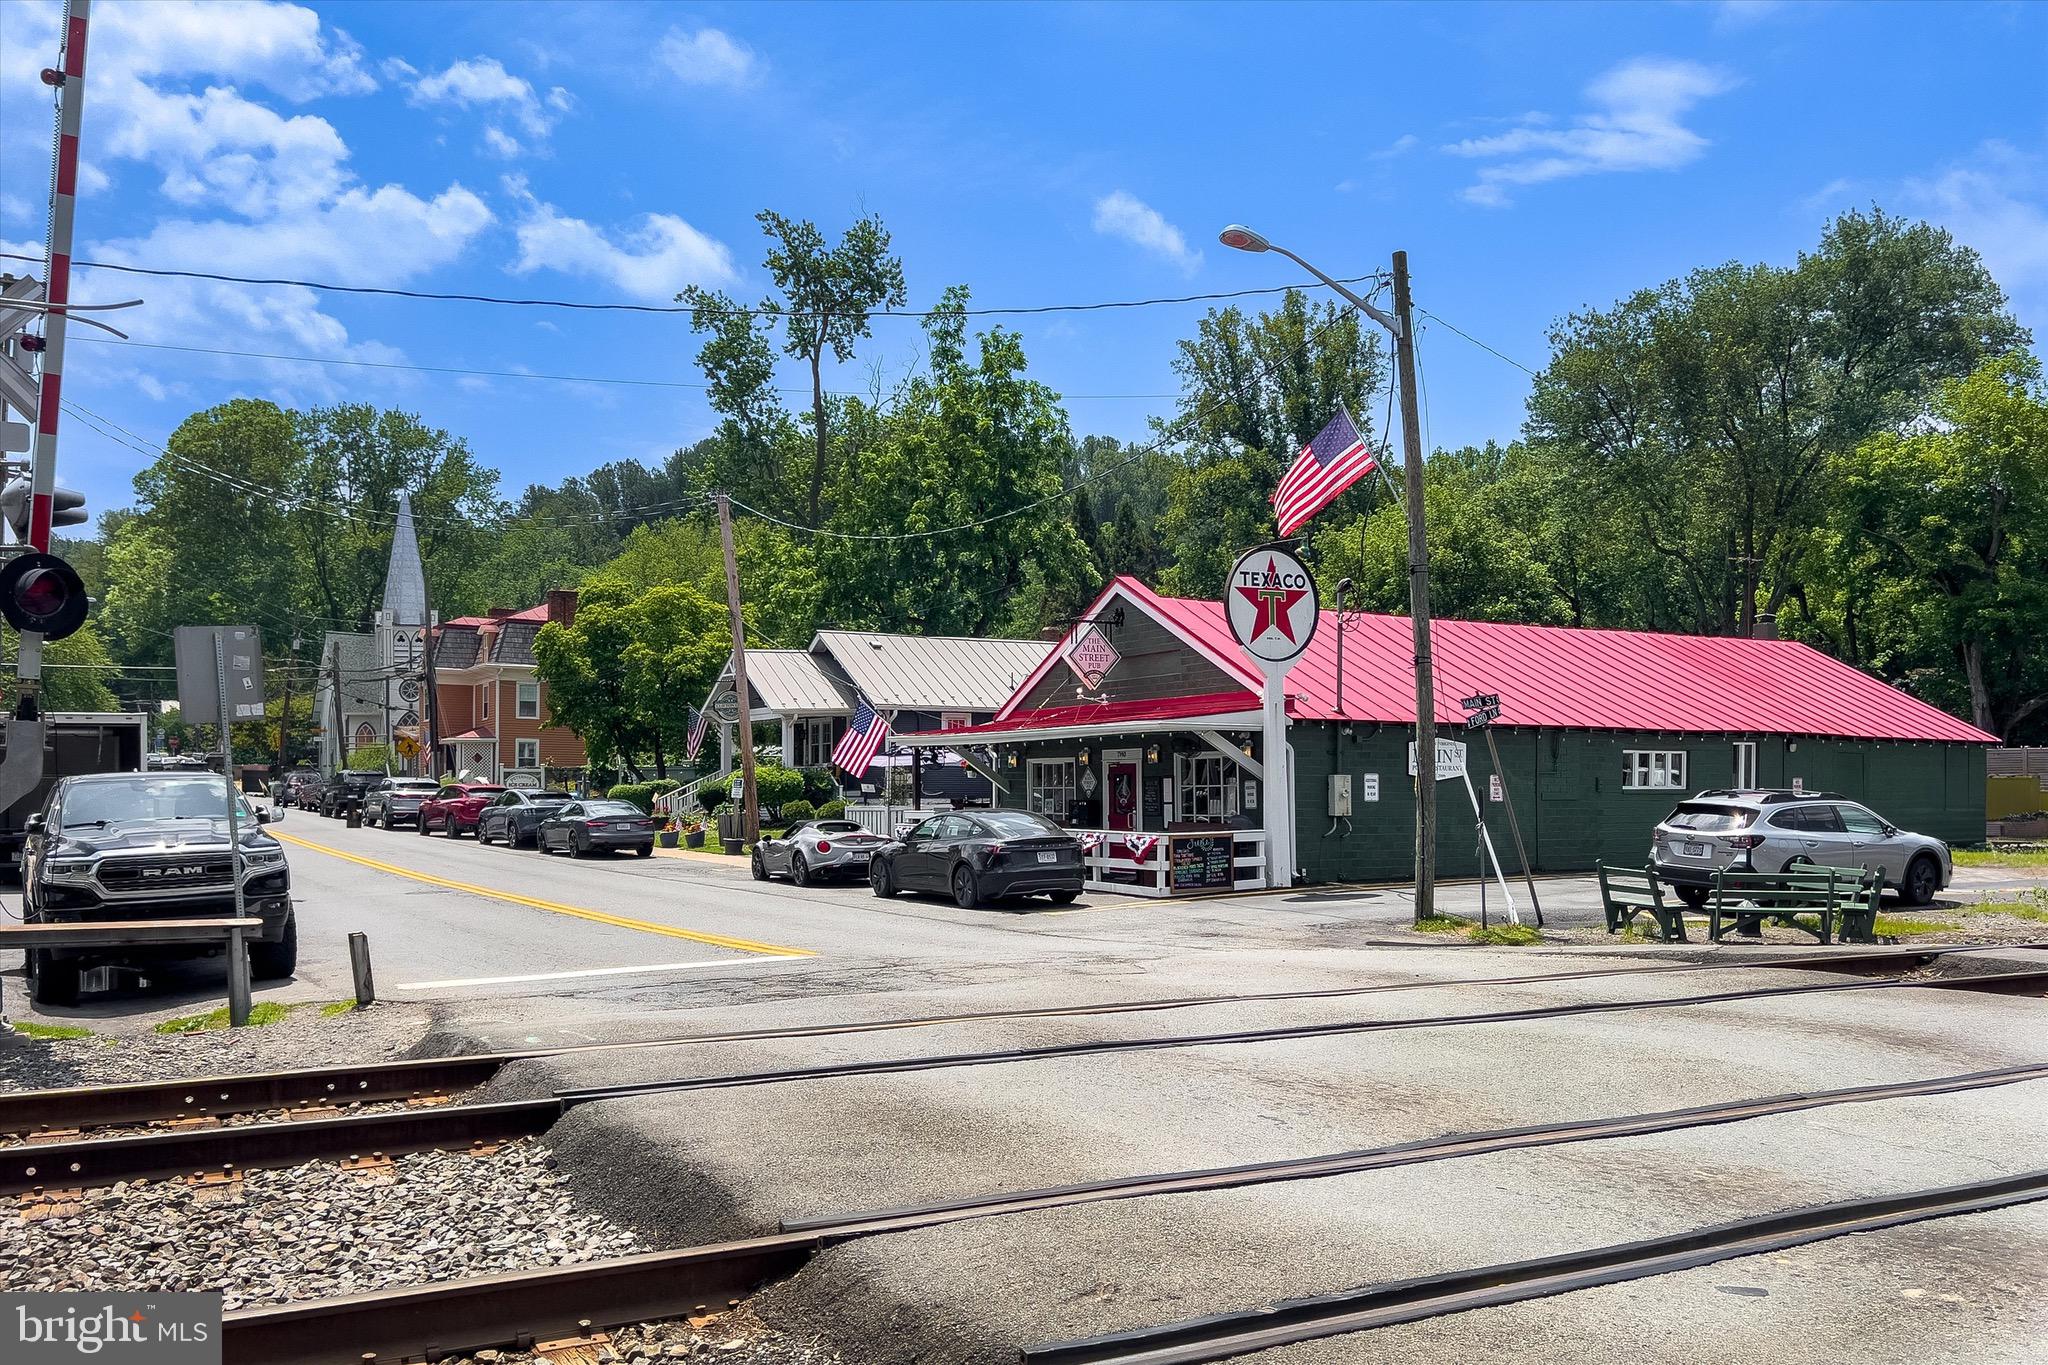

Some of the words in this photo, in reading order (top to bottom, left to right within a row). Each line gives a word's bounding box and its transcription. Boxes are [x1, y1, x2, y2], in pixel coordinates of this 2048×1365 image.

[1239, 570, 1306, 589] TEXACO
[1257, 589, 1287, 626] T
[1082, 644, 1106, 653] MAIN
[1078, 653, 1110, 662] STREET
[1462, 698, 1483, 708] MAIN
[1485, 696, 1496, 706] ST
[1471, 712, 1488, 727] FORD
[1489, 708, 1498, 719] LN
[142, 866, 203, 877] RAM
